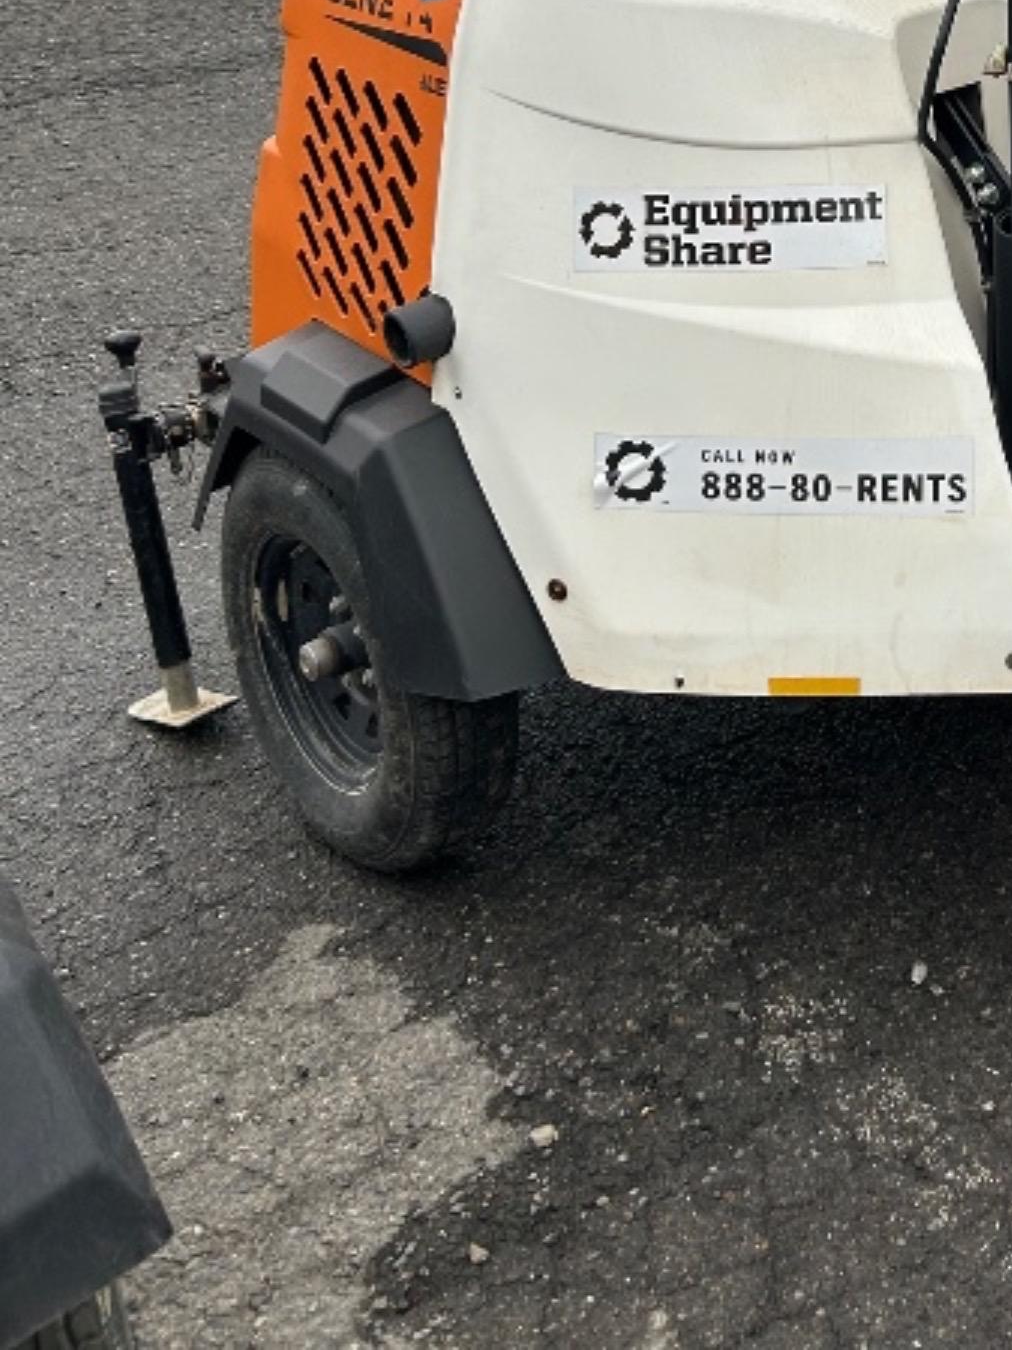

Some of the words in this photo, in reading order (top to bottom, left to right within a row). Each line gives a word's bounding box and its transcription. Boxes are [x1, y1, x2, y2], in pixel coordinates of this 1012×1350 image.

[643, 191, 883, 234] Equipment
[643, 233, 772, 267] Share
[701, 449, 744, 464] CALL
[755, 449, 796, 465] NOW
[701, 471, 967, 503] 888-80-RENTS
